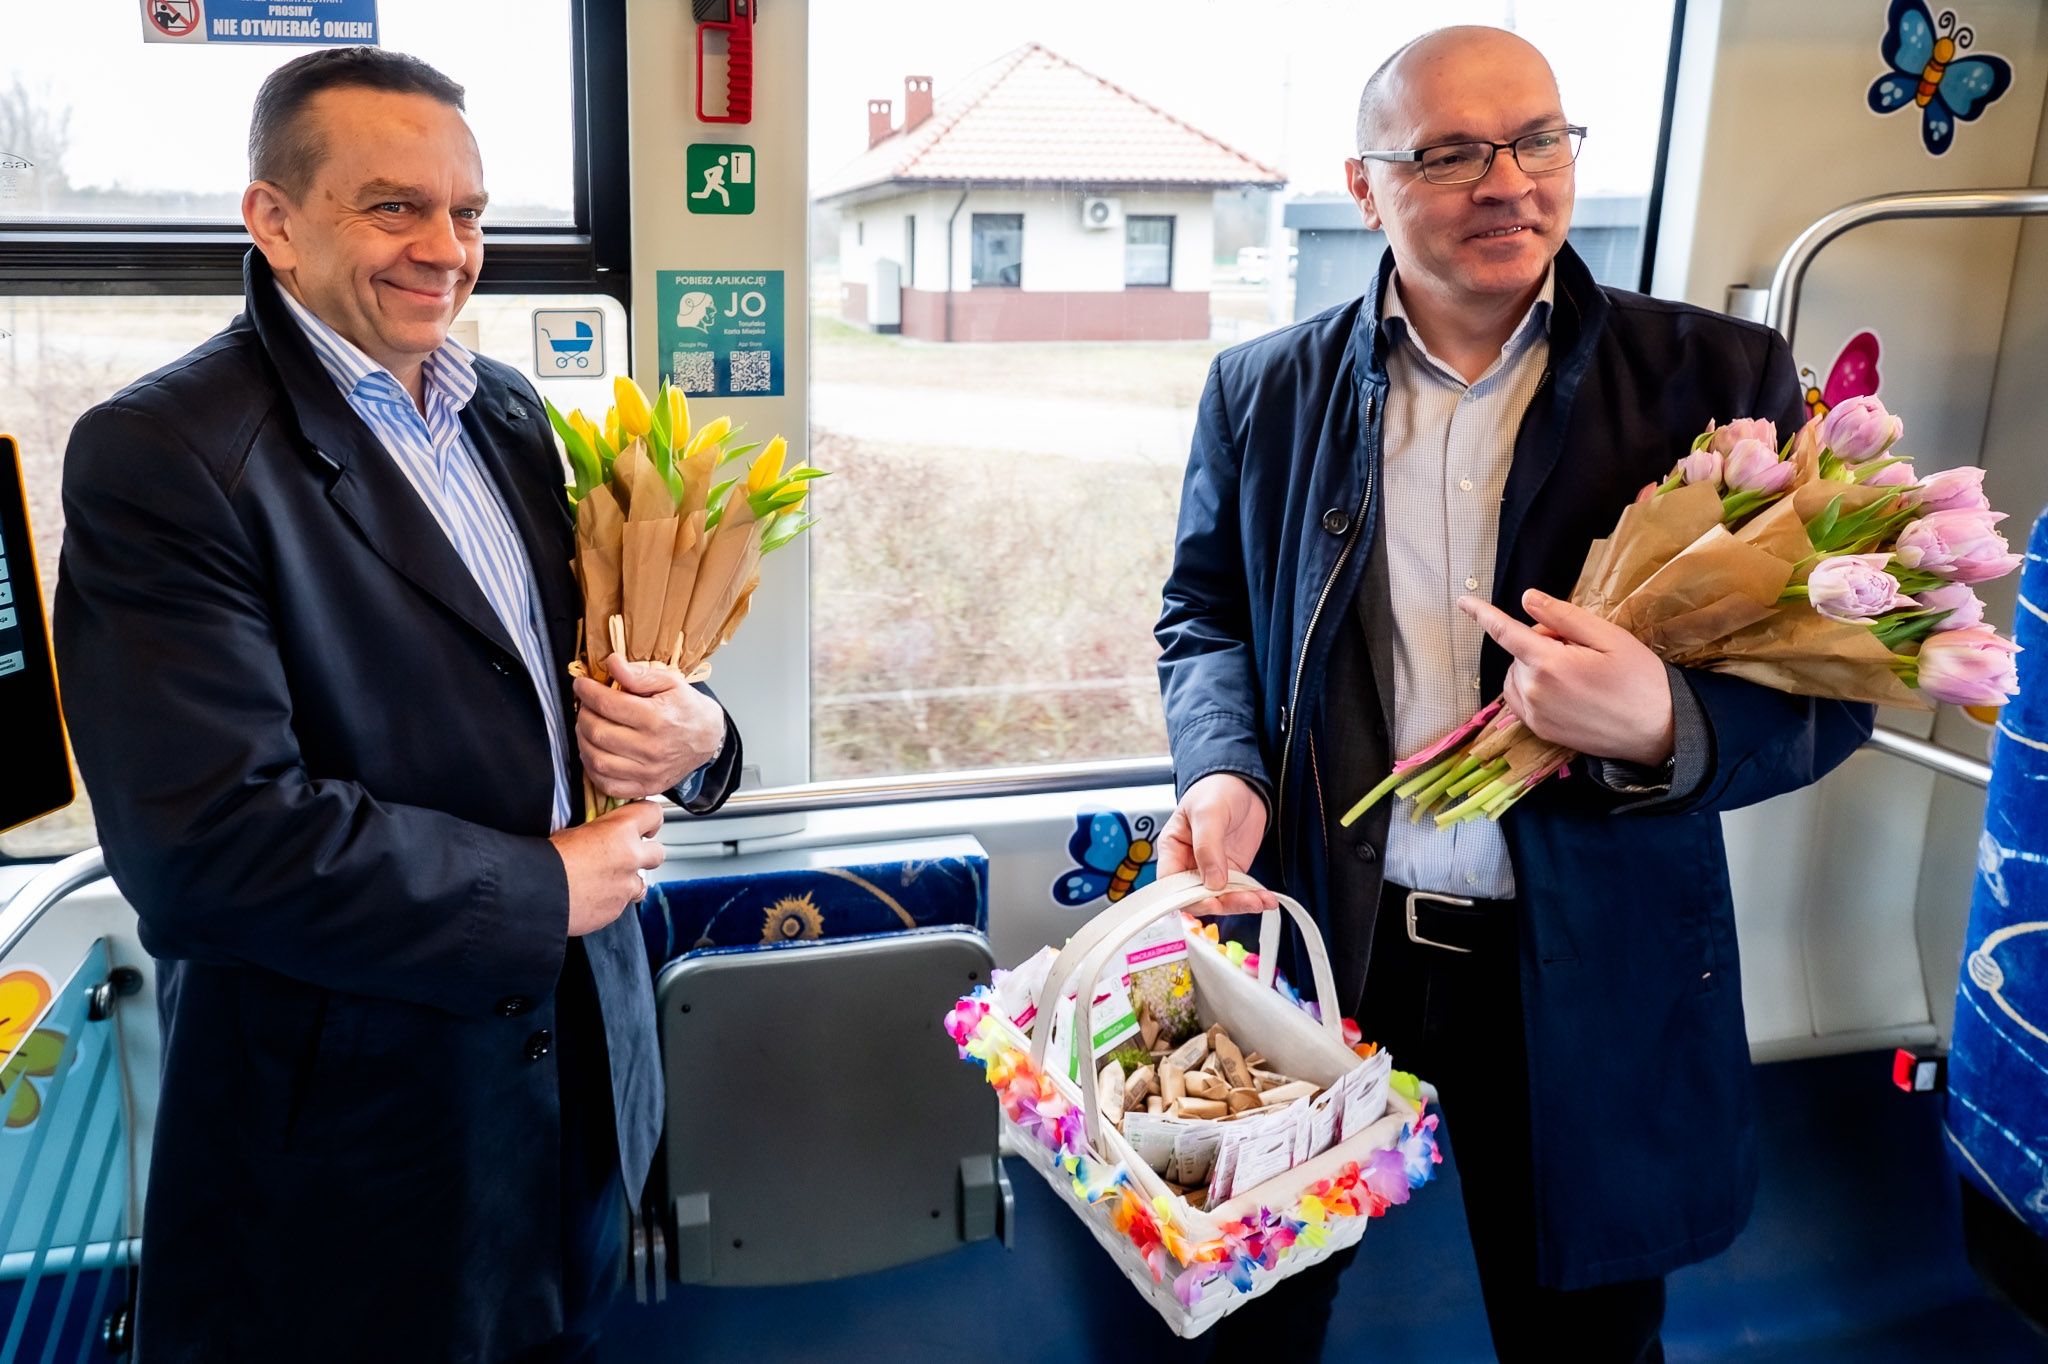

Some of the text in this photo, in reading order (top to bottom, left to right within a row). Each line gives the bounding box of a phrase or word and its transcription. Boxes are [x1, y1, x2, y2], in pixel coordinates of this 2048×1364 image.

[268, 5, 313, 17] PROSIMY
[213, 17, 373, 39] NIE OTWIERAĆ OKIEN!
[675, 276, 713, 285] POBIERZ
[724, 291, 766, 318] JO
